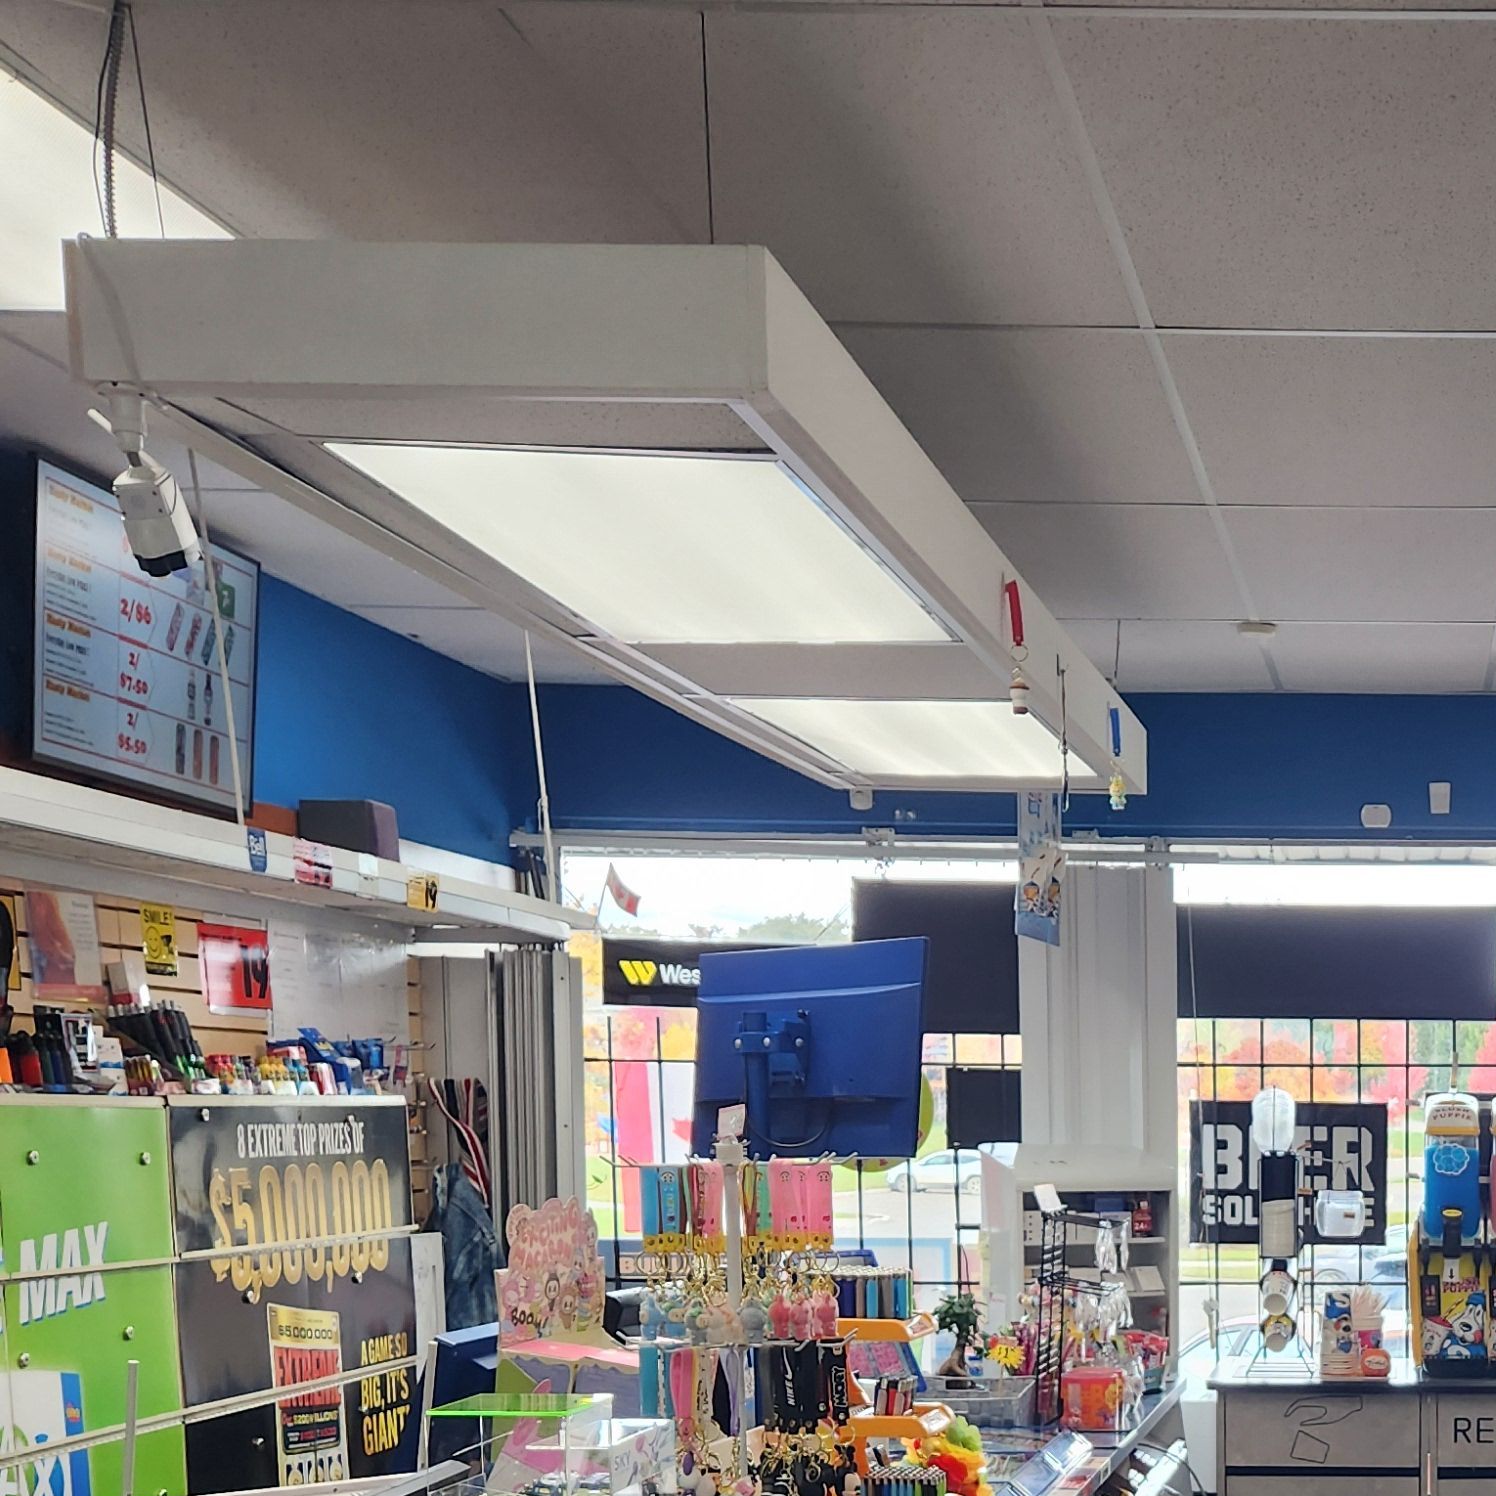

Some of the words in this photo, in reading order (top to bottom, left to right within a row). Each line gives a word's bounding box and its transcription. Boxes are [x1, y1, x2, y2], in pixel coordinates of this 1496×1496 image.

[659, 963, 702, 986] Wes
[237, 1123, 247, 1159] 8
[248, 1122, 298, 1158] EXTREME
[299, 1122, 318, 1156] TOP
[318, 1121, 352, 1155] PRIZES
[352, 1120, 365, 1154] OF
[1202, 1122, 1374, 1193] BER
[1202, 1195, 1258, 1226] SOL
[18, 1221, 108, 1326] MAX
[360, 1340, 367, 1366] A
[368, 1334, 394, 1365] GAME
[394, 1331, 408, 1358] SO
[362, 1404, 411, 1456] GIANT
